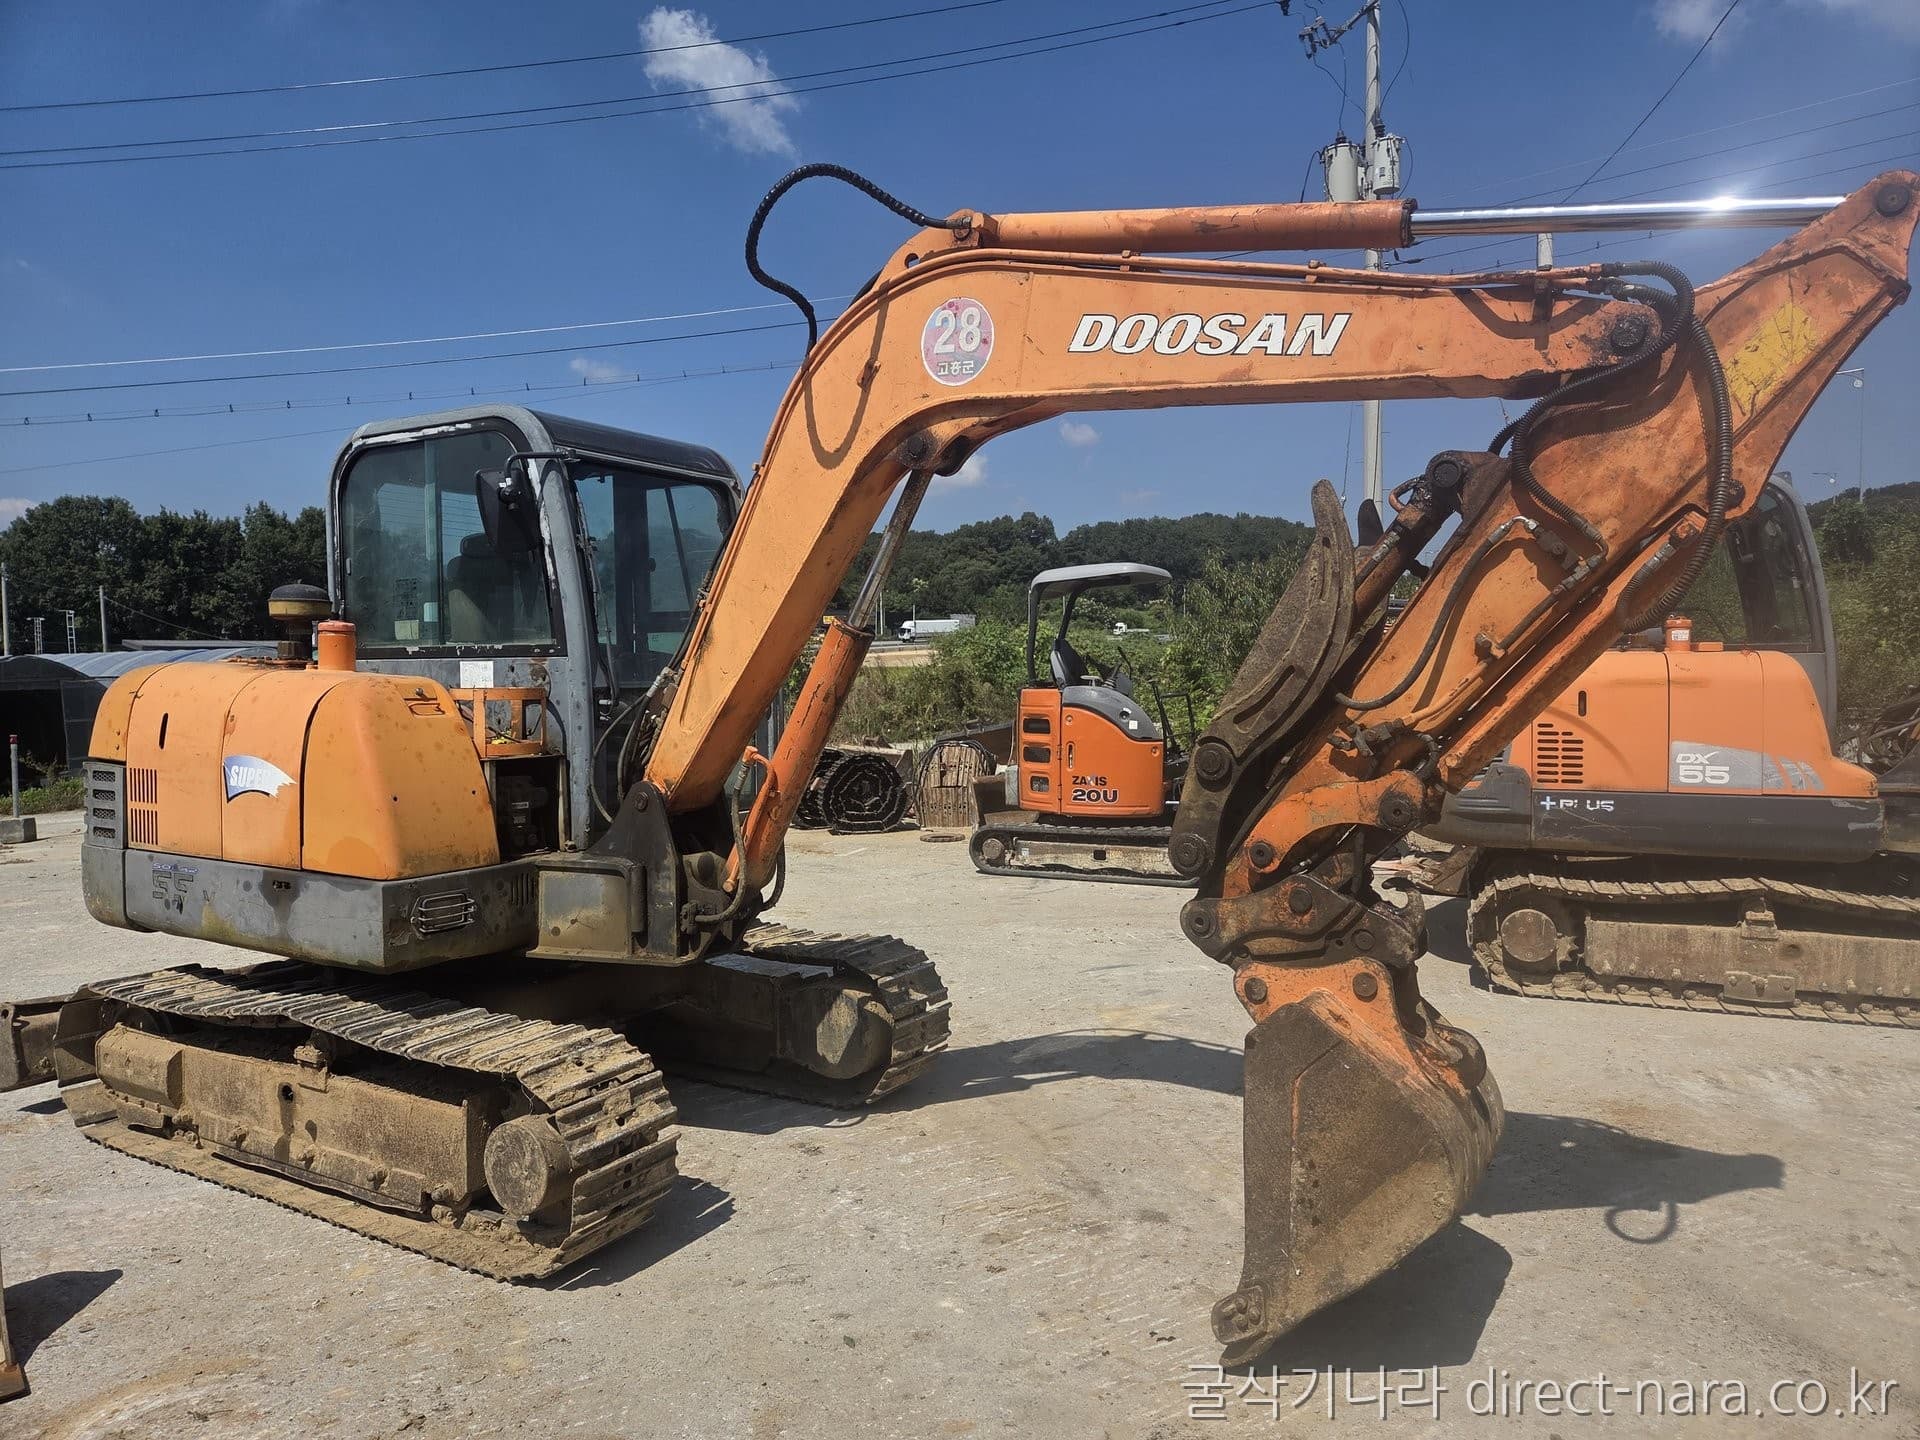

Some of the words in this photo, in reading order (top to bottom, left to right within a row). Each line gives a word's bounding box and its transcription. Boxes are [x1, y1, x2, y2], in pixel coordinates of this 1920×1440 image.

[933, 307, 981, 354] 28
[1067, 313, 1352, 356] DOOSAN
[938, 360, 974, 376] 고흥군
[1675, 751, 1720, 765] DX
[1679, 765, 1730, 784] 55
[1072, 788, 1118, 803] 20U
